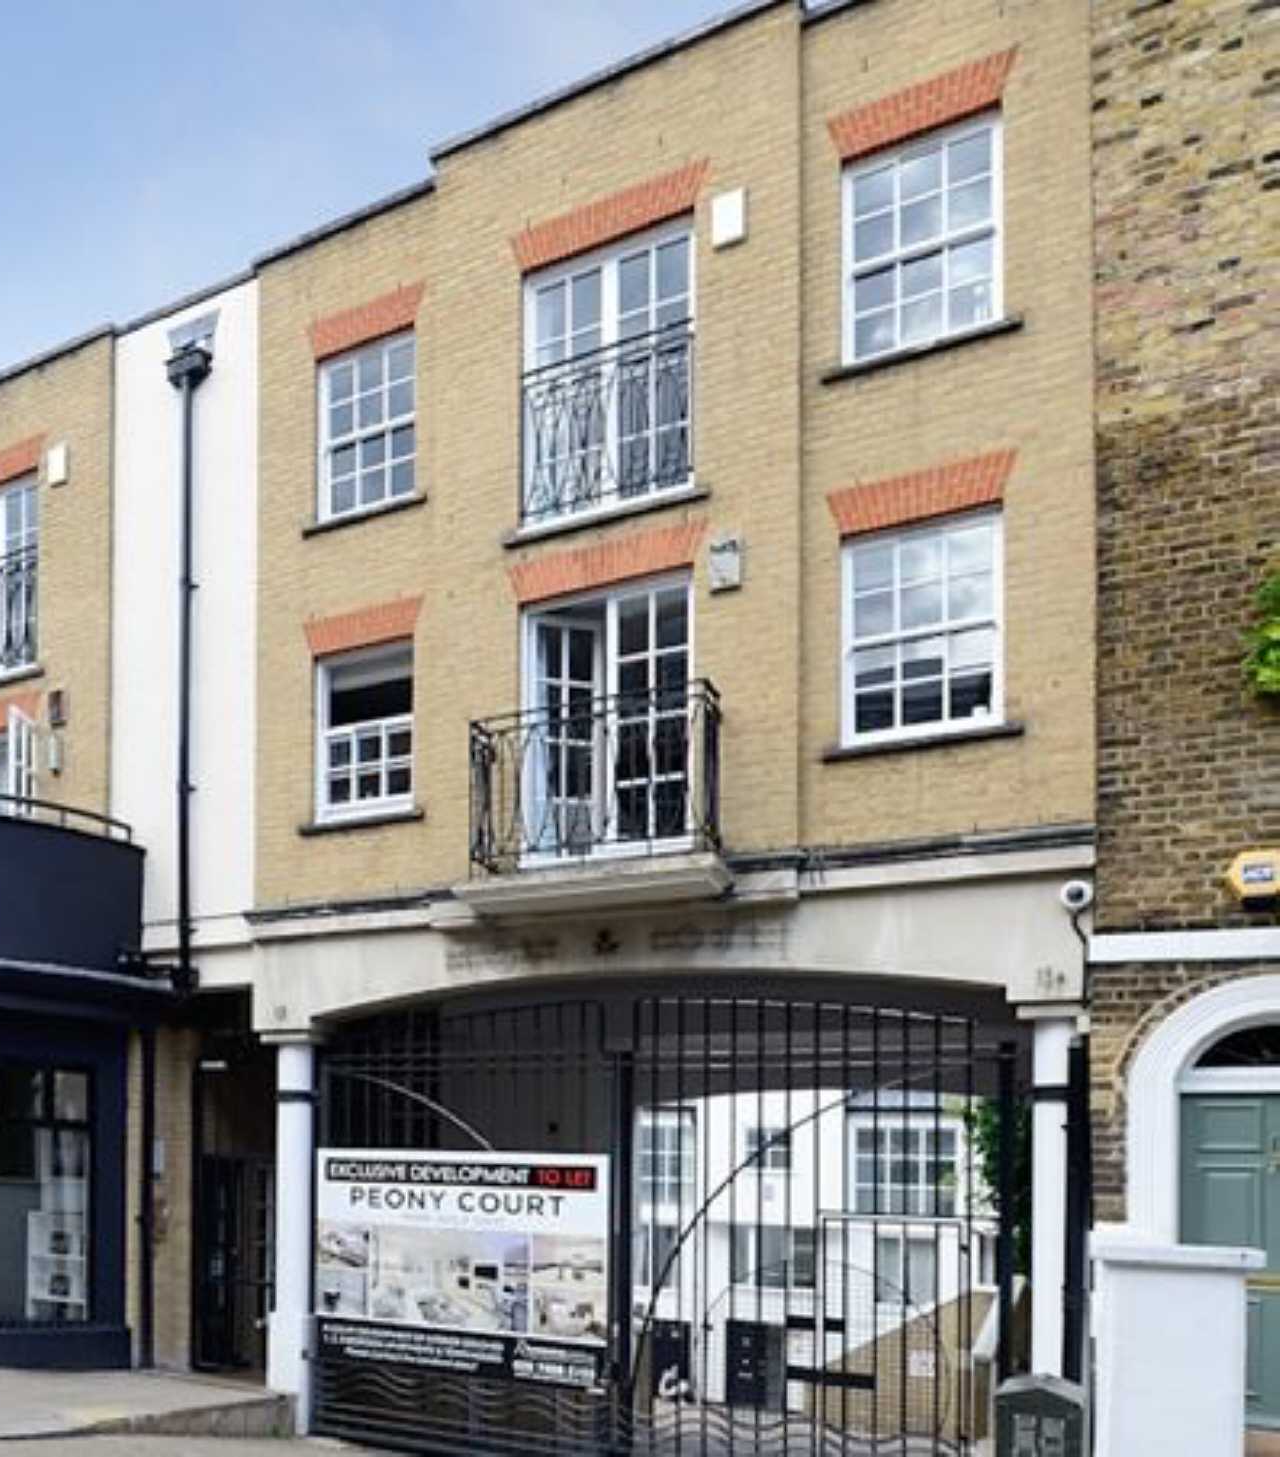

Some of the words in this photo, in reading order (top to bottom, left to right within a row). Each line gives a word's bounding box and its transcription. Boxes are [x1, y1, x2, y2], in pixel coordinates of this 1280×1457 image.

[330, 1163, 406, 1181] EXCLUSIVE
[411, 1166, 530, 1185] DEVELOPMENT
[536, 1169, 560, 1185] TO
[565, 1169, 592, 1187] LET
[350, 1186, 446, 1210] PEONY
[458, 1191, 566, 1216] COURT
